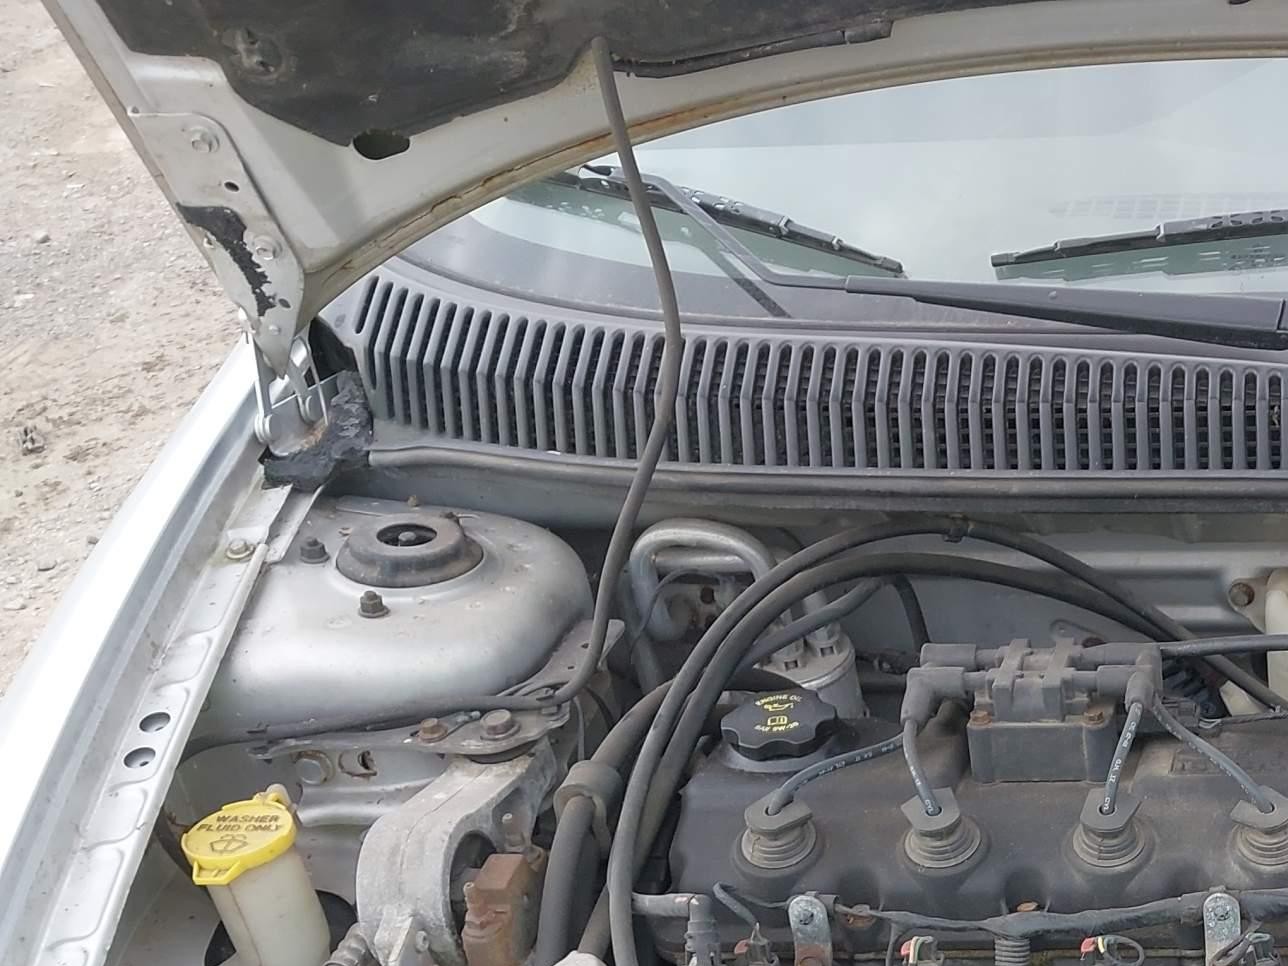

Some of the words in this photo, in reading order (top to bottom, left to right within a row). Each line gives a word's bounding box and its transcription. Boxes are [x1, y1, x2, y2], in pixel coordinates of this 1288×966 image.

[755, 694, 788, 706] ENGINE
[216, 815, 281, 824] WASHER
[197, 824, 242, 833] FLUID
[244, 823, 284, 832] ONLY
